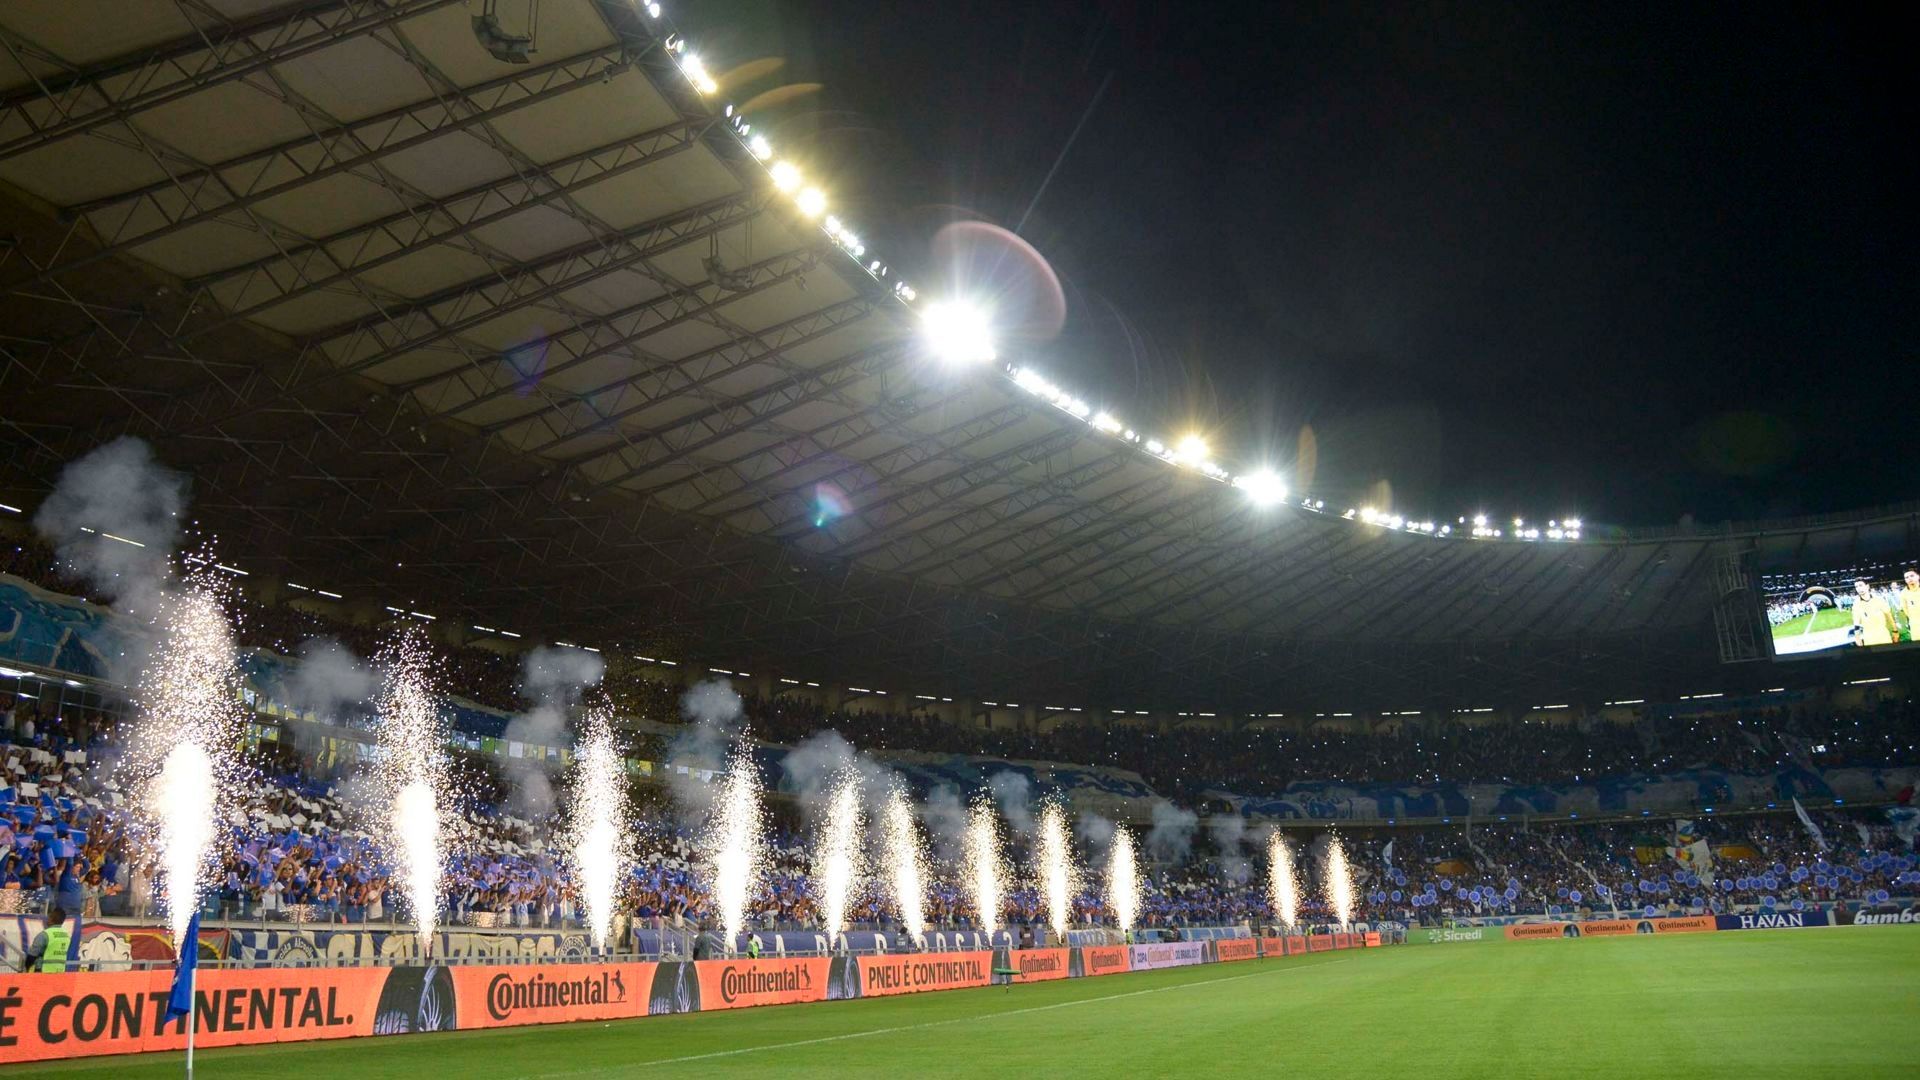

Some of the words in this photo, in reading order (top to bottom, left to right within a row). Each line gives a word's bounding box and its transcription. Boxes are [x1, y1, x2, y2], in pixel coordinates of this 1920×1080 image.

[1585, 923, 1626, 934] Continental
[1658, 919, 1700, 930] Continental
[1740, 913, 1804, 929] HAVAN
[1444, 929, 1482, 942] Sicredi
[1513, 926, 1553, 937] Continental
[1020, 953, 1056, 976] Continental
[868, 965, 900, 990] PNEU
[903, 961, 910, 986] É
[913, 960, 985, 985] CONTINENTAL.
[720, 964, 800, 1004] Continental
[487, 972, 609, 1021] Continental
